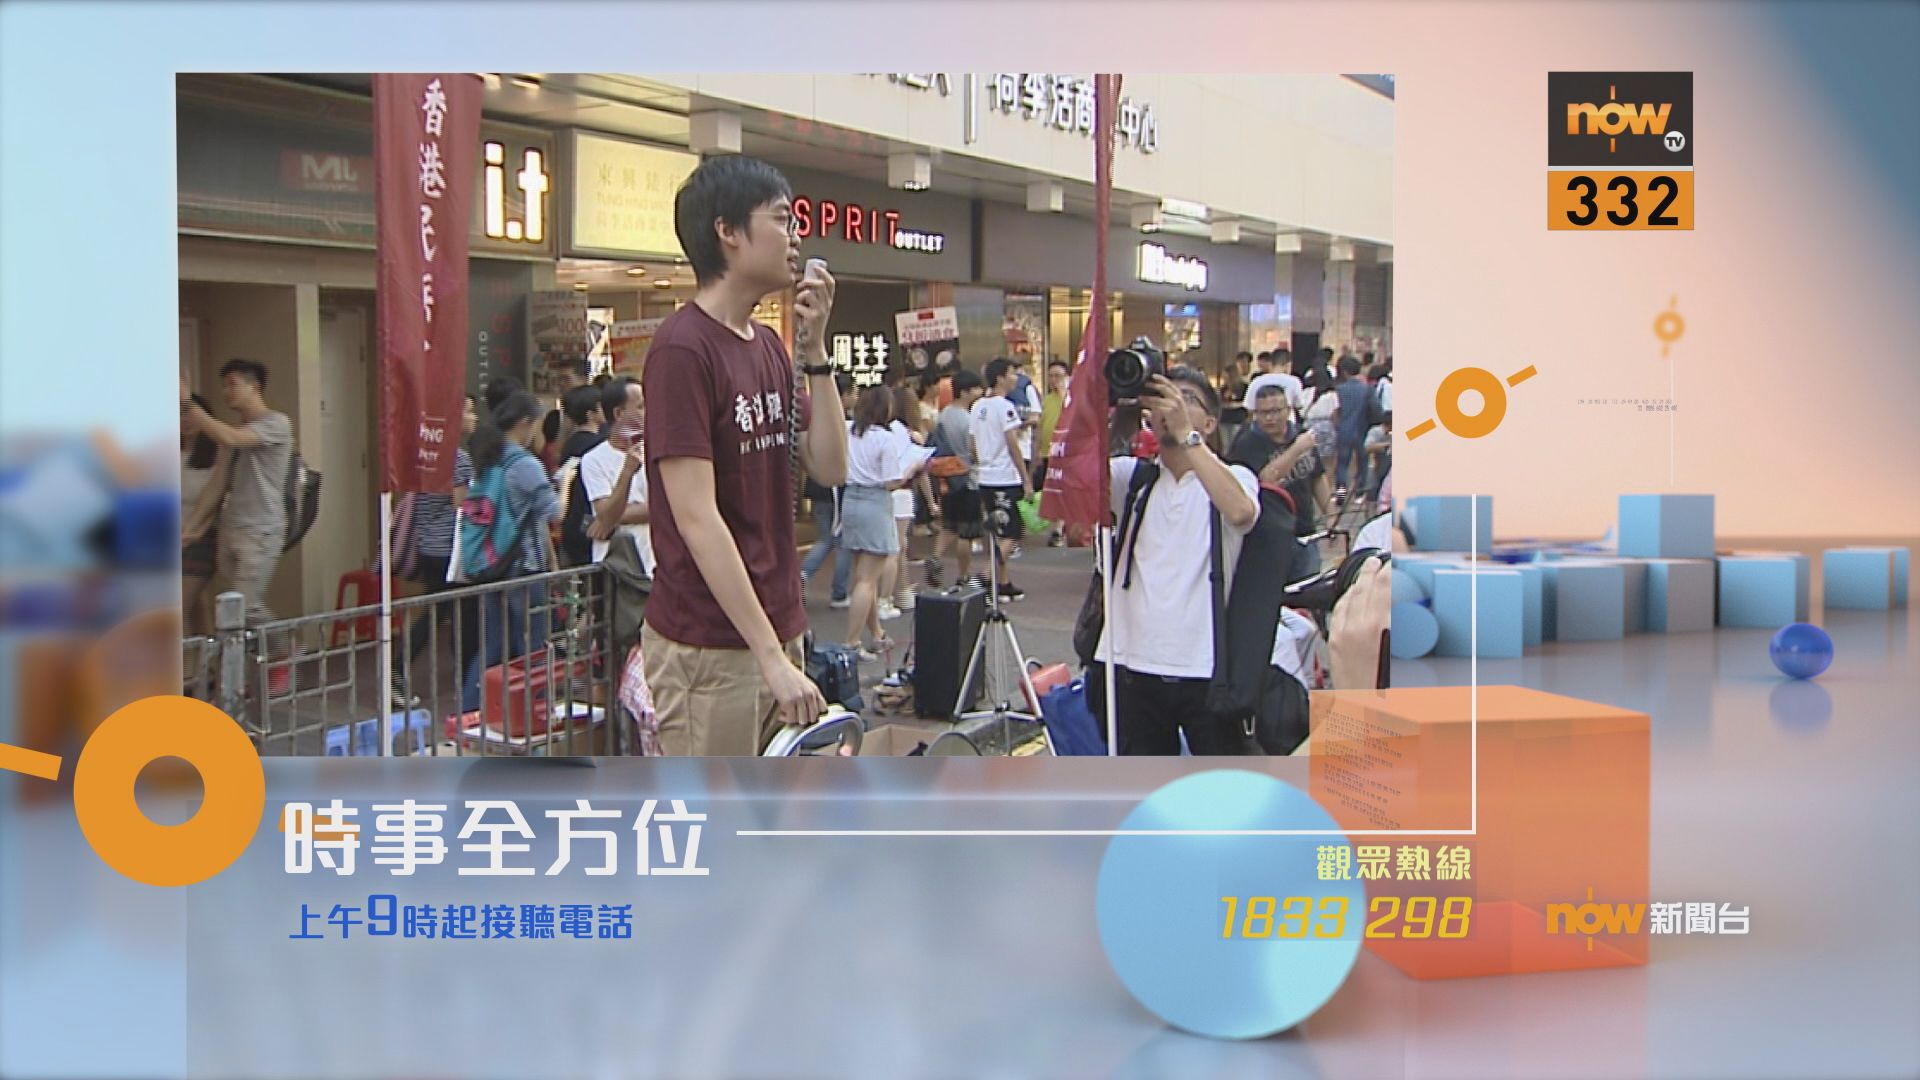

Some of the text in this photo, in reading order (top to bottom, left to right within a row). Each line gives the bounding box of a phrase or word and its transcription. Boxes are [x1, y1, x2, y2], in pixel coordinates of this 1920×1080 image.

[988, 73, 1158, 153] 荷李活商中心
[484, 140, 549, 244] i.t
[793, 197, 944, 252] SPRIT OUTLET
[829, 333, 889, 372] 周生生
